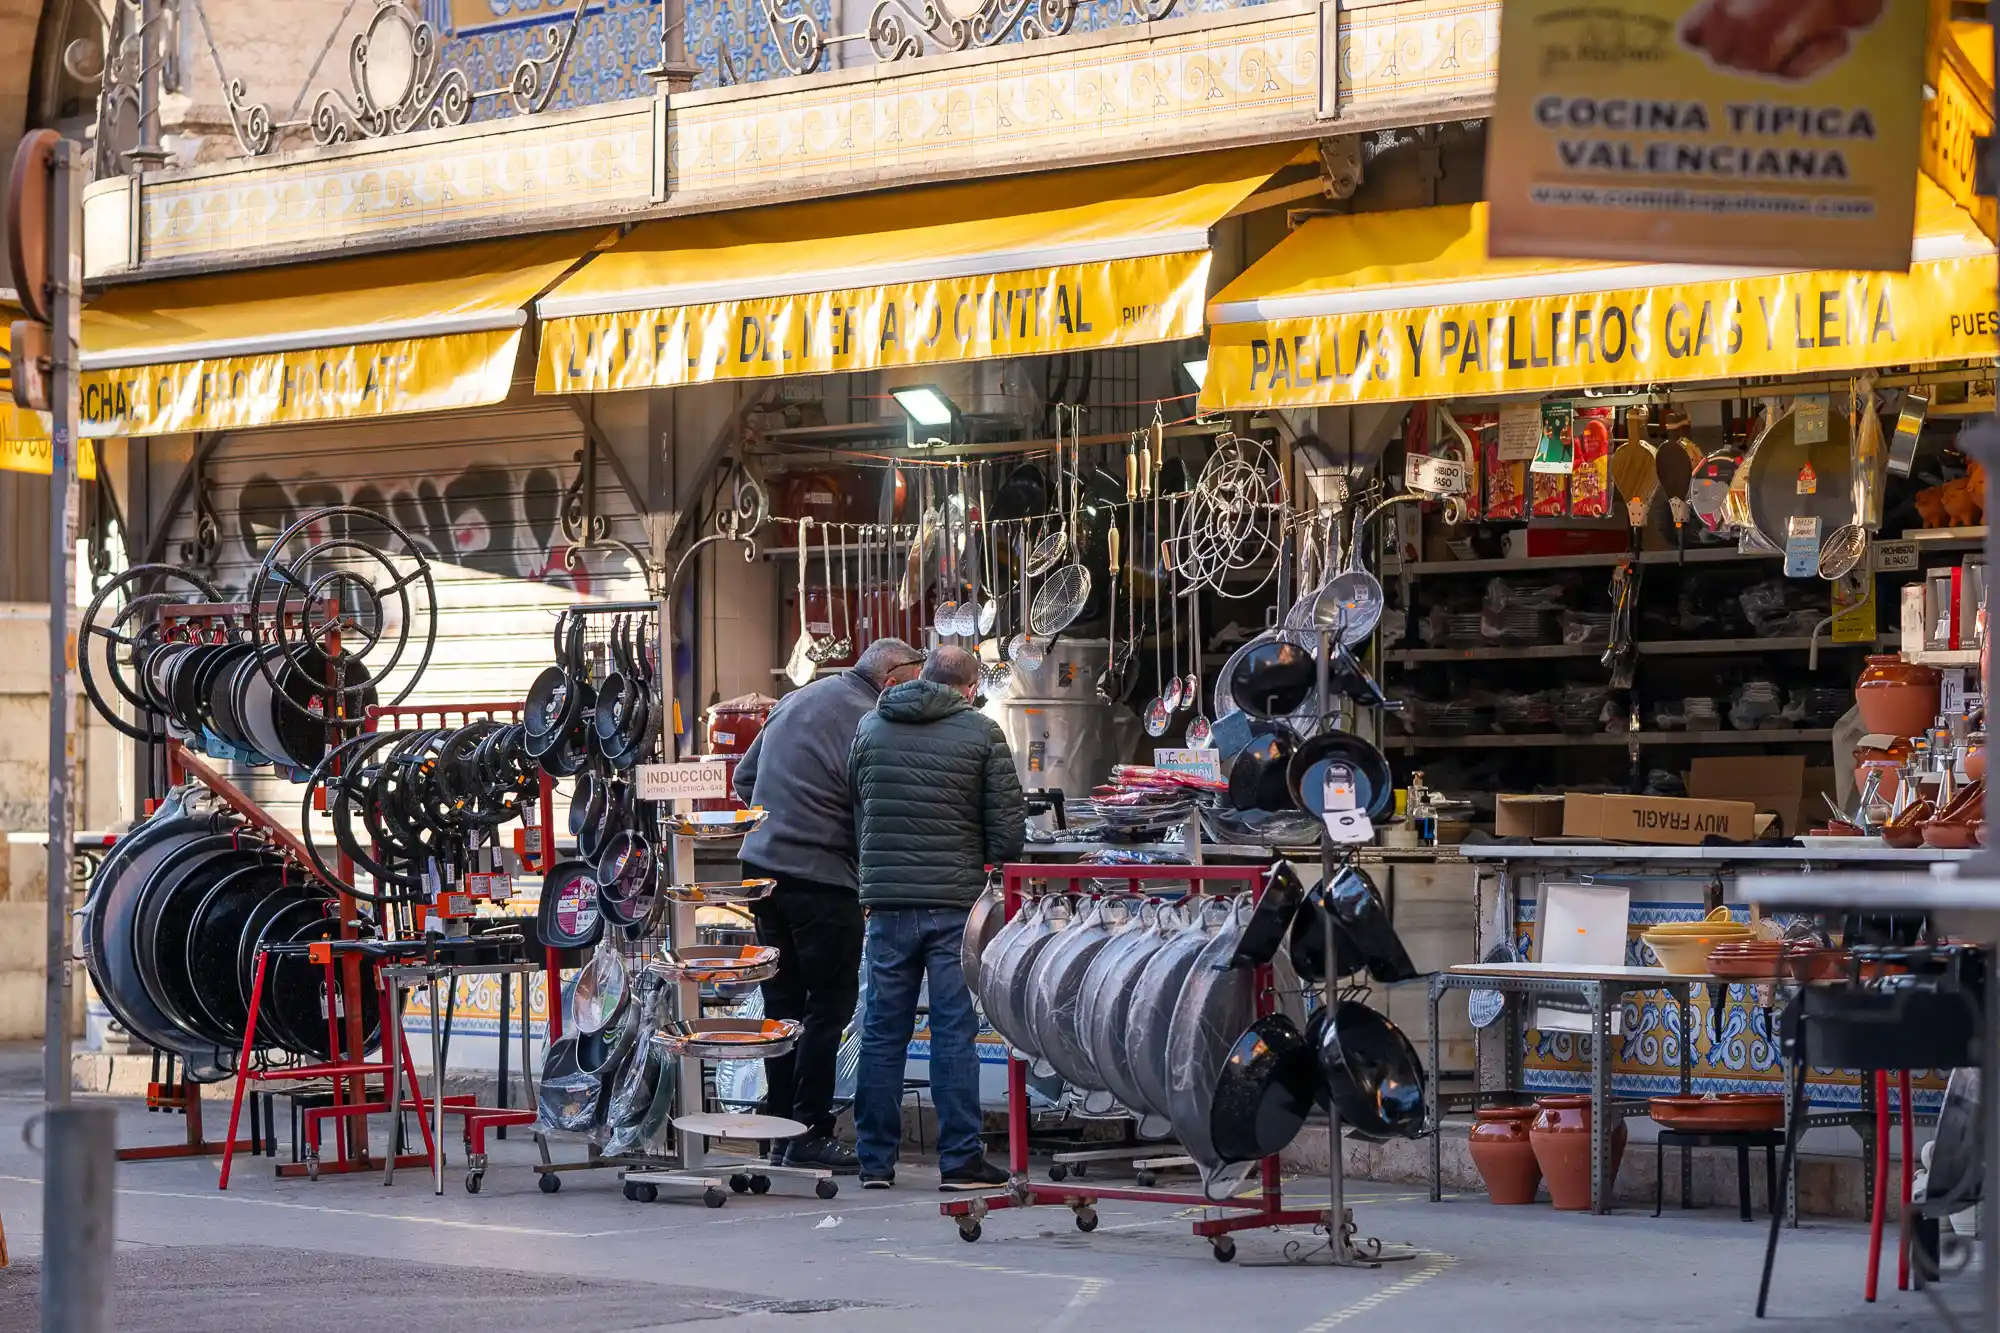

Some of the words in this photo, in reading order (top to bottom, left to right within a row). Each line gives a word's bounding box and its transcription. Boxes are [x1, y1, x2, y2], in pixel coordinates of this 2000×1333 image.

[1535, 97, 1709, 132] COCINA
[1726, 101, 1877, 140] TÍPICA
[1557, 139, 1849, 180] VALENCIANA
[1250, 325, 1394, 391] PAELLAS
[1405, 323, 1427, 378] Y
[1440, 301, 1651, 377] PAELLEROS
[1664, 295, 1743, 358] GAS
[1759, 291, 1787, 351] Y
[1795, 275, 1897, 348] LEÑA
[646, 765, 722, 785] INDUCCIÓN
[709, 783, 724, 791] GAS
[1632, 809, 1690, 831] FRAGIL
[1693, 813, 1729, 833] MUY
